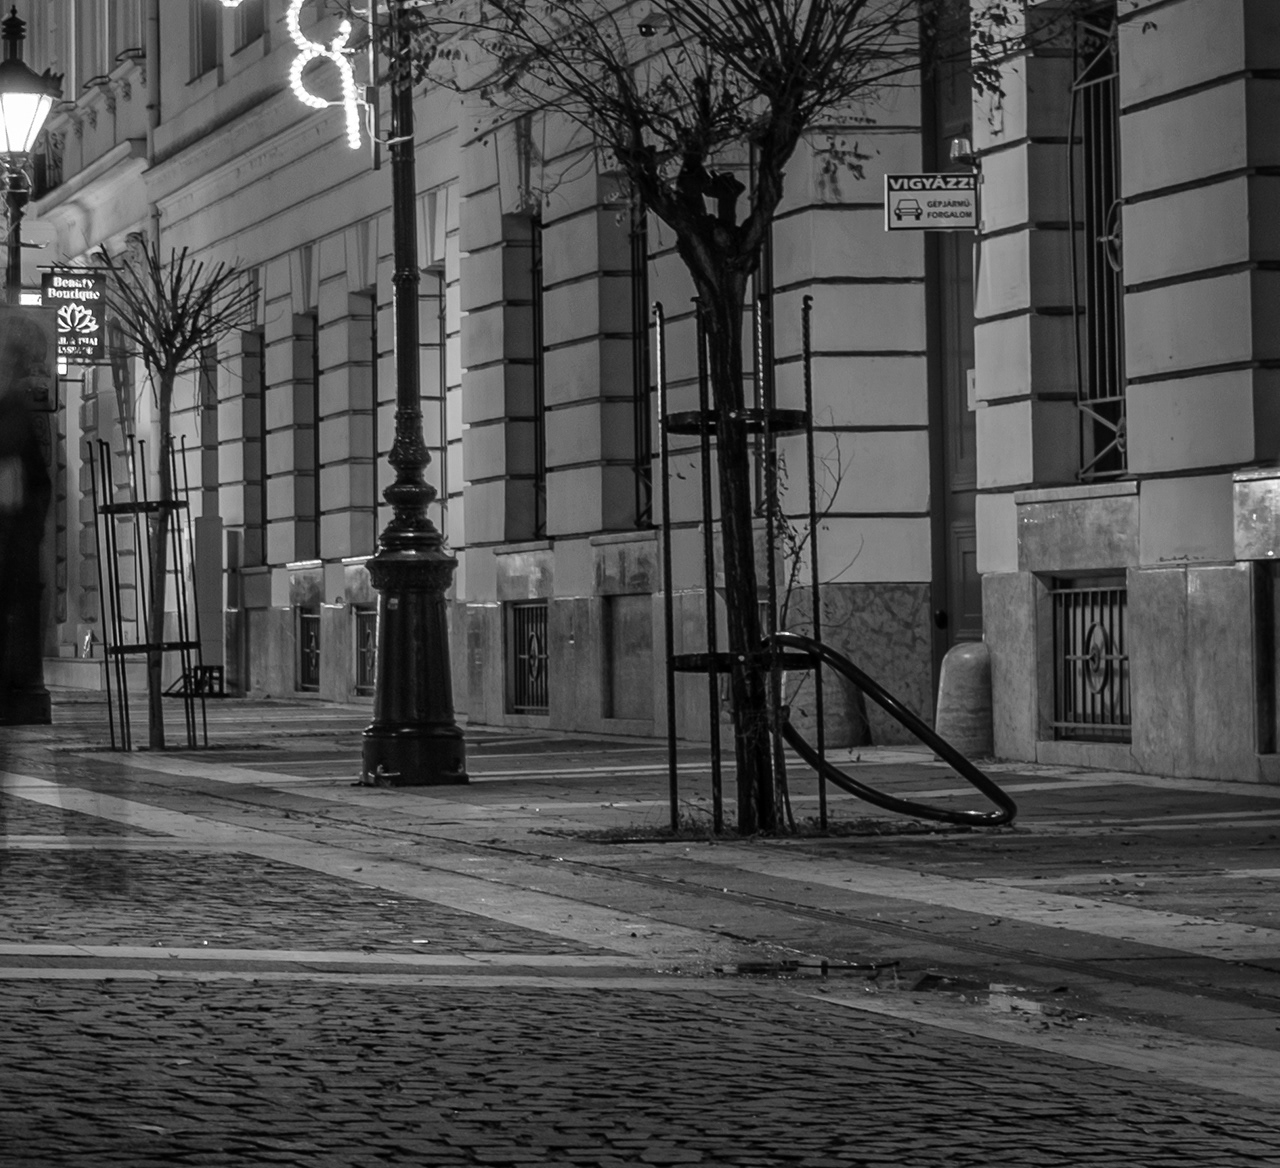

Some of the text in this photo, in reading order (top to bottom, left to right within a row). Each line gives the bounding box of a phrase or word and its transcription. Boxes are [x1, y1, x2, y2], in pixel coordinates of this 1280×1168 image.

[889, 175, 975, 190] VIGYÁZZ!
[927, 211, 972, 219] FORGALOM
[53, 276, 96, 289] Beauty
[48, 288, 100, 301] Boutique
